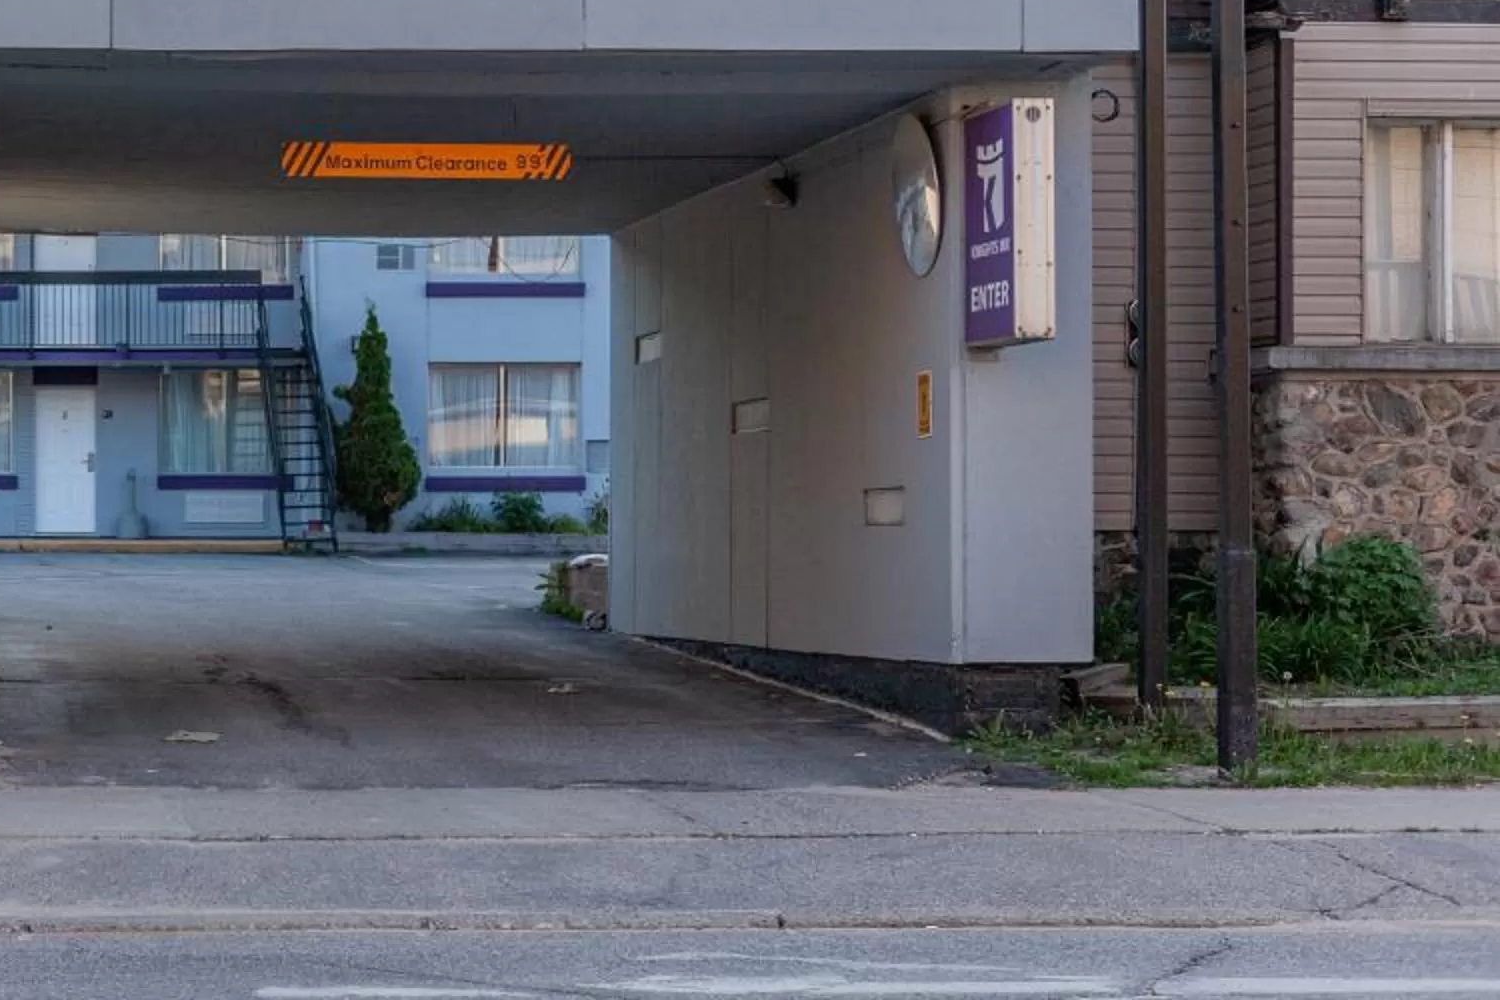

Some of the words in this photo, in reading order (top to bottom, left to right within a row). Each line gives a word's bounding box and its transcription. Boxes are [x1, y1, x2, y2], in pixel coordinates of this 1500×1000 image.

[325, 154, 412, 170] Maximum
[415, 154, 507, 171] Clearance
[971, 280, 1009, 312] ENTER
